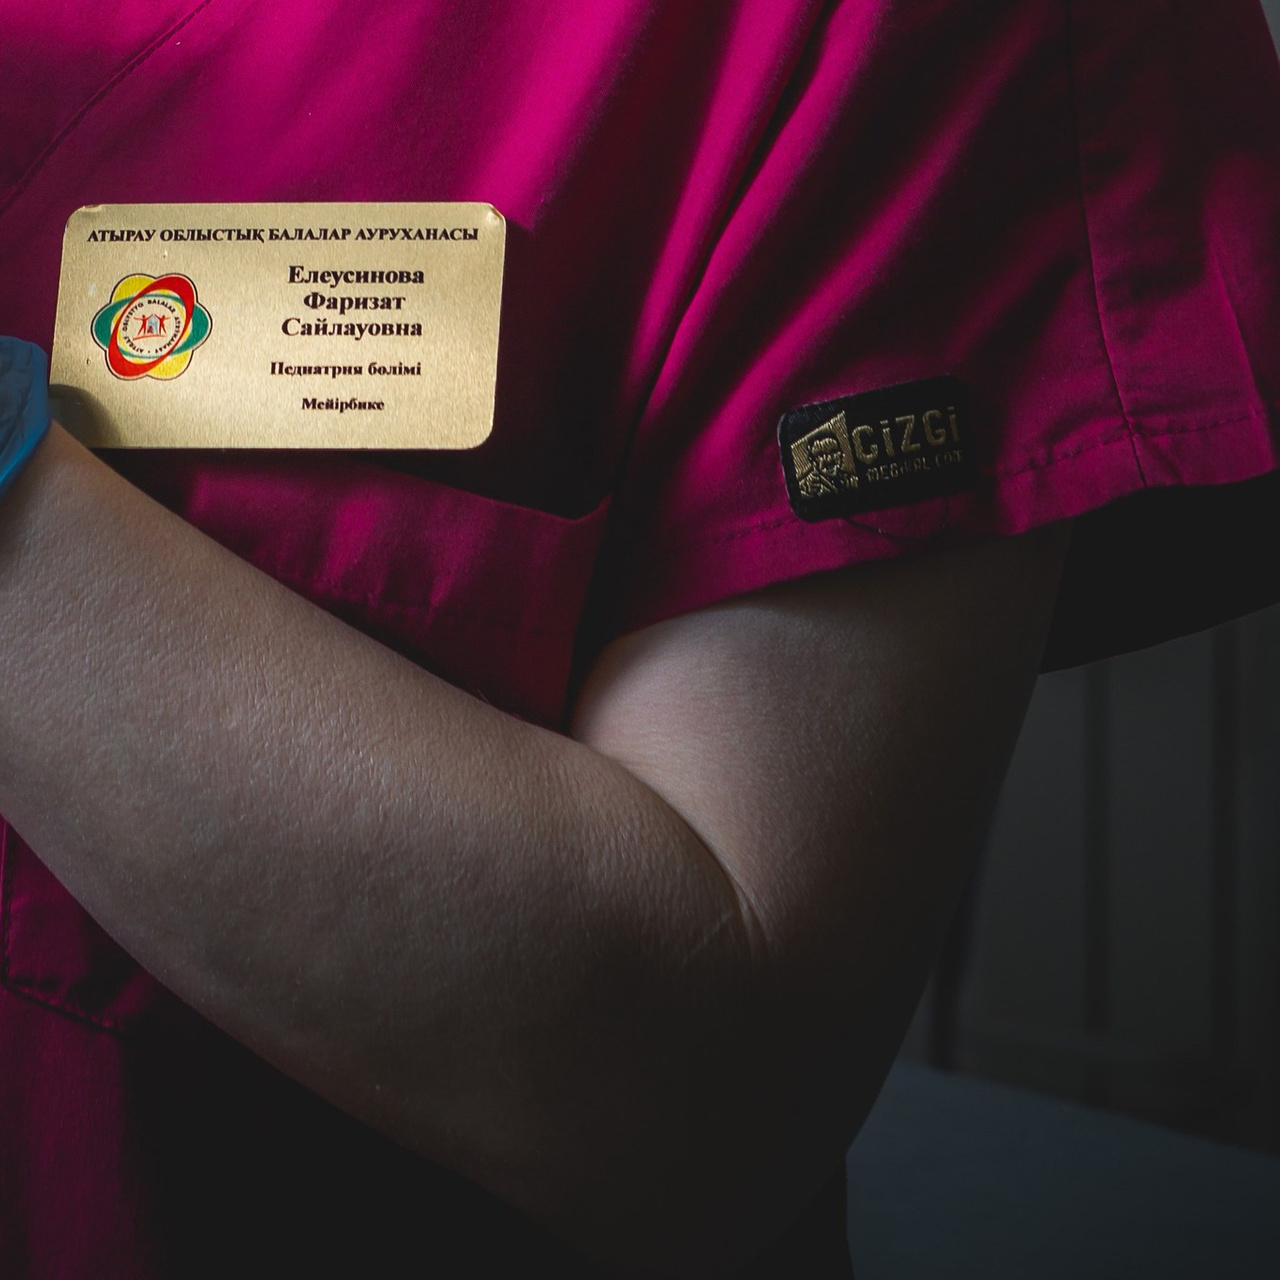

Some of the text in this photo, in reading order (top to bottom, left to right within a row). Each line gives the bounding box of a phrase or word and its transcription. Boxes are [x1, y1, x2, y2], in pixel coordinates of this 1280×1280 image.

[88, 228, 479, 244] АТЫРАУ ОБЛЫСТЫҚ БАЛАЛАР АУРУХАНАСЫ
[288, 265, 425, 287] Елеусинова
[303, 292, 406, 315] Фаризат
[280, 317, 423, 339] Сайлауовна
[270, 362, 363, 379] Педиатрия
[301, 398, 385, 414] Мейірбике
